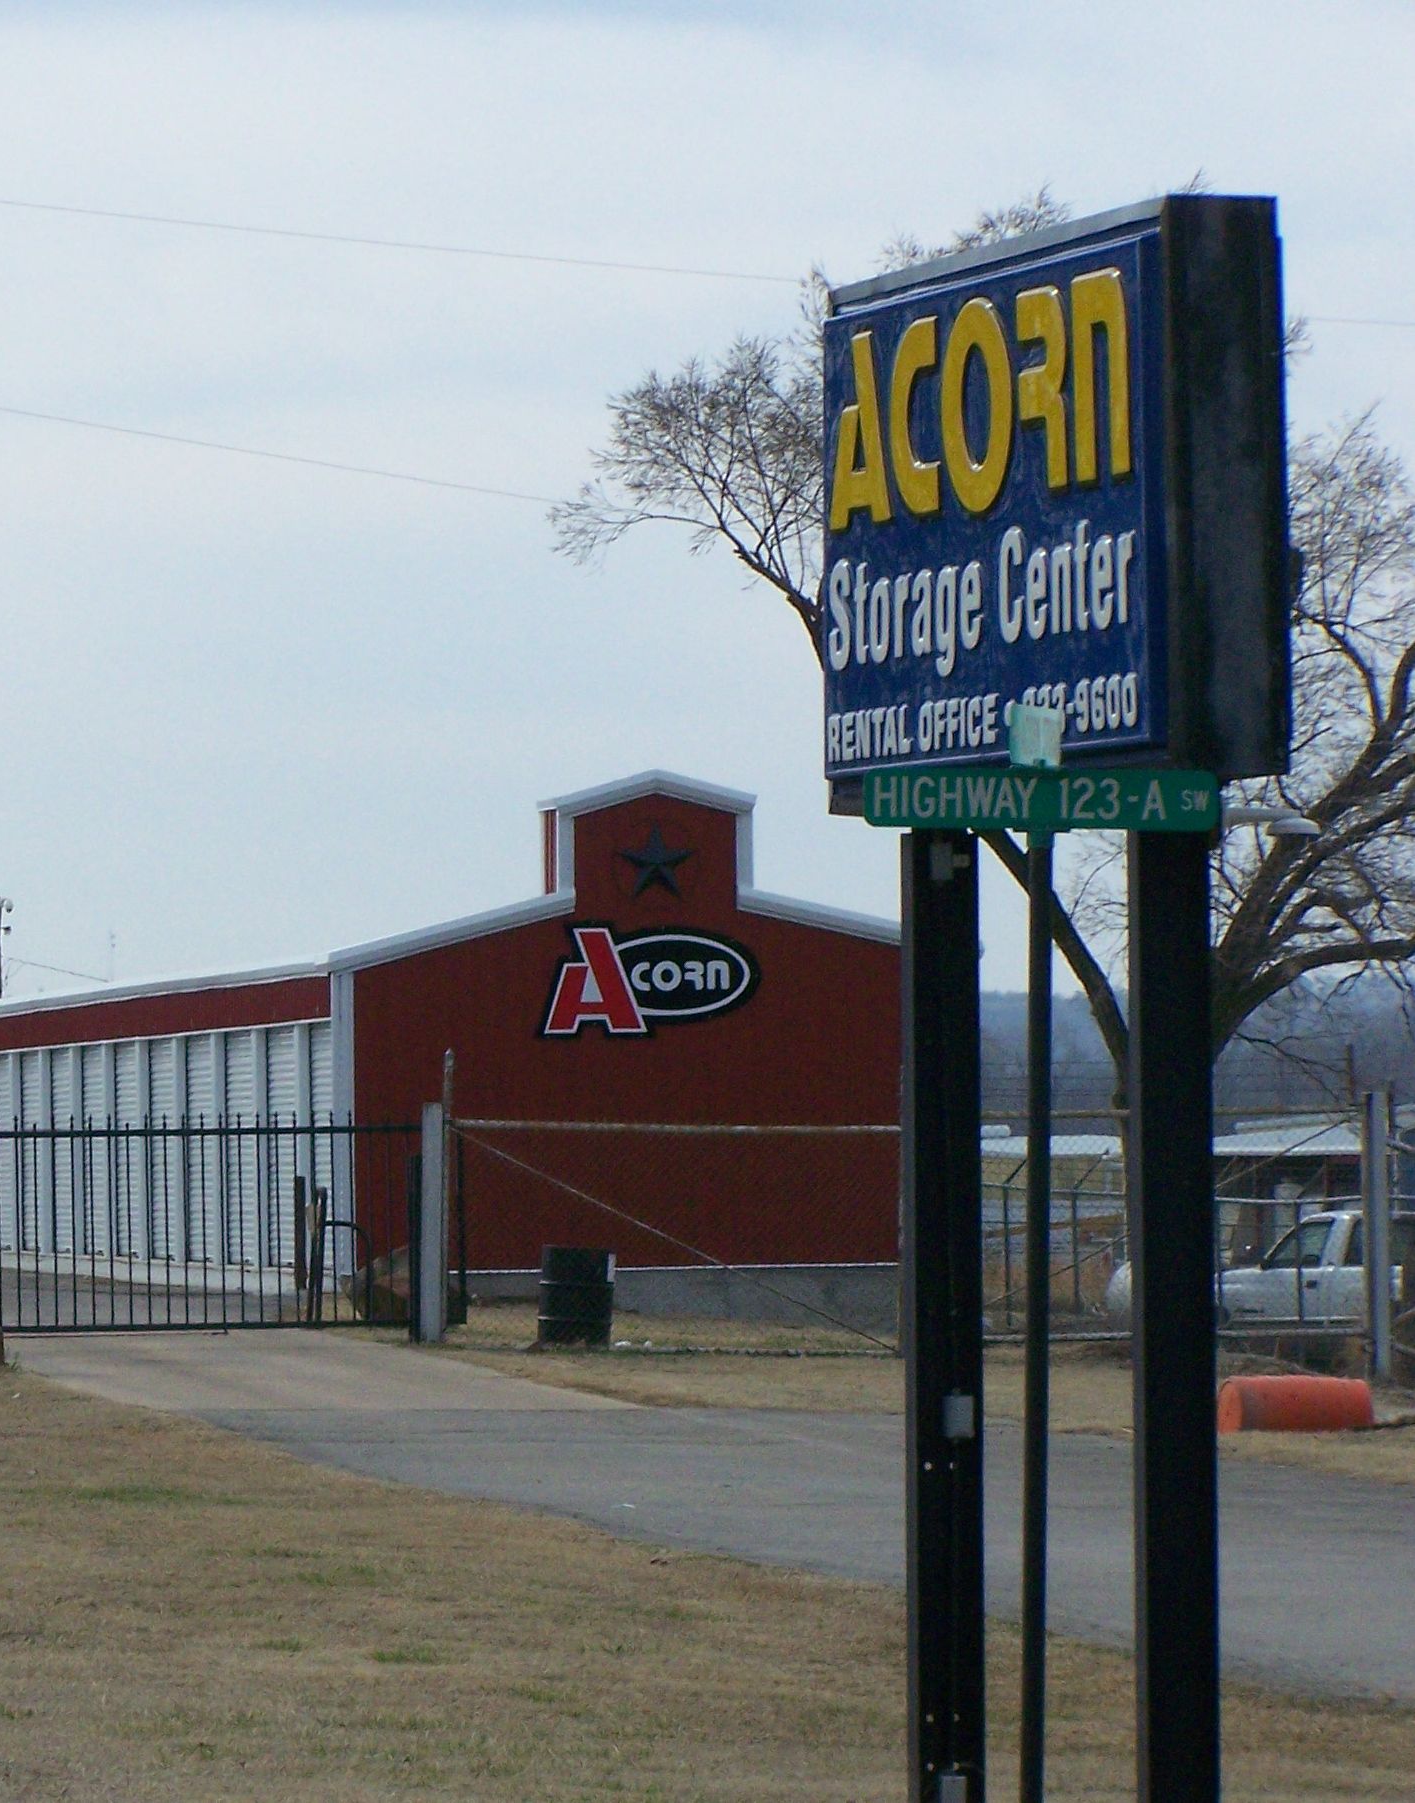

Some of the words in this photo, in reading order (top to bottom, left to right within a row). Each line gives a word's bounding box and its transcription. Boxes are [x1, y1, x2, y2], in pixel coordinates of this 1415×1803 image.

[828, 266, 1132, 532] ACORN
[828, 557, 985, 678] Storage
[998, 518, 1136, 644] Center
[827, 703, 912, 762] RENTAL
[918, 692, 1000, 753] OFFICE
[873, 776, 1038, 820] HIGHWAY
[1059, 777, 1167, 822] 123-A
[1180, 789, 1210, 813] SW
